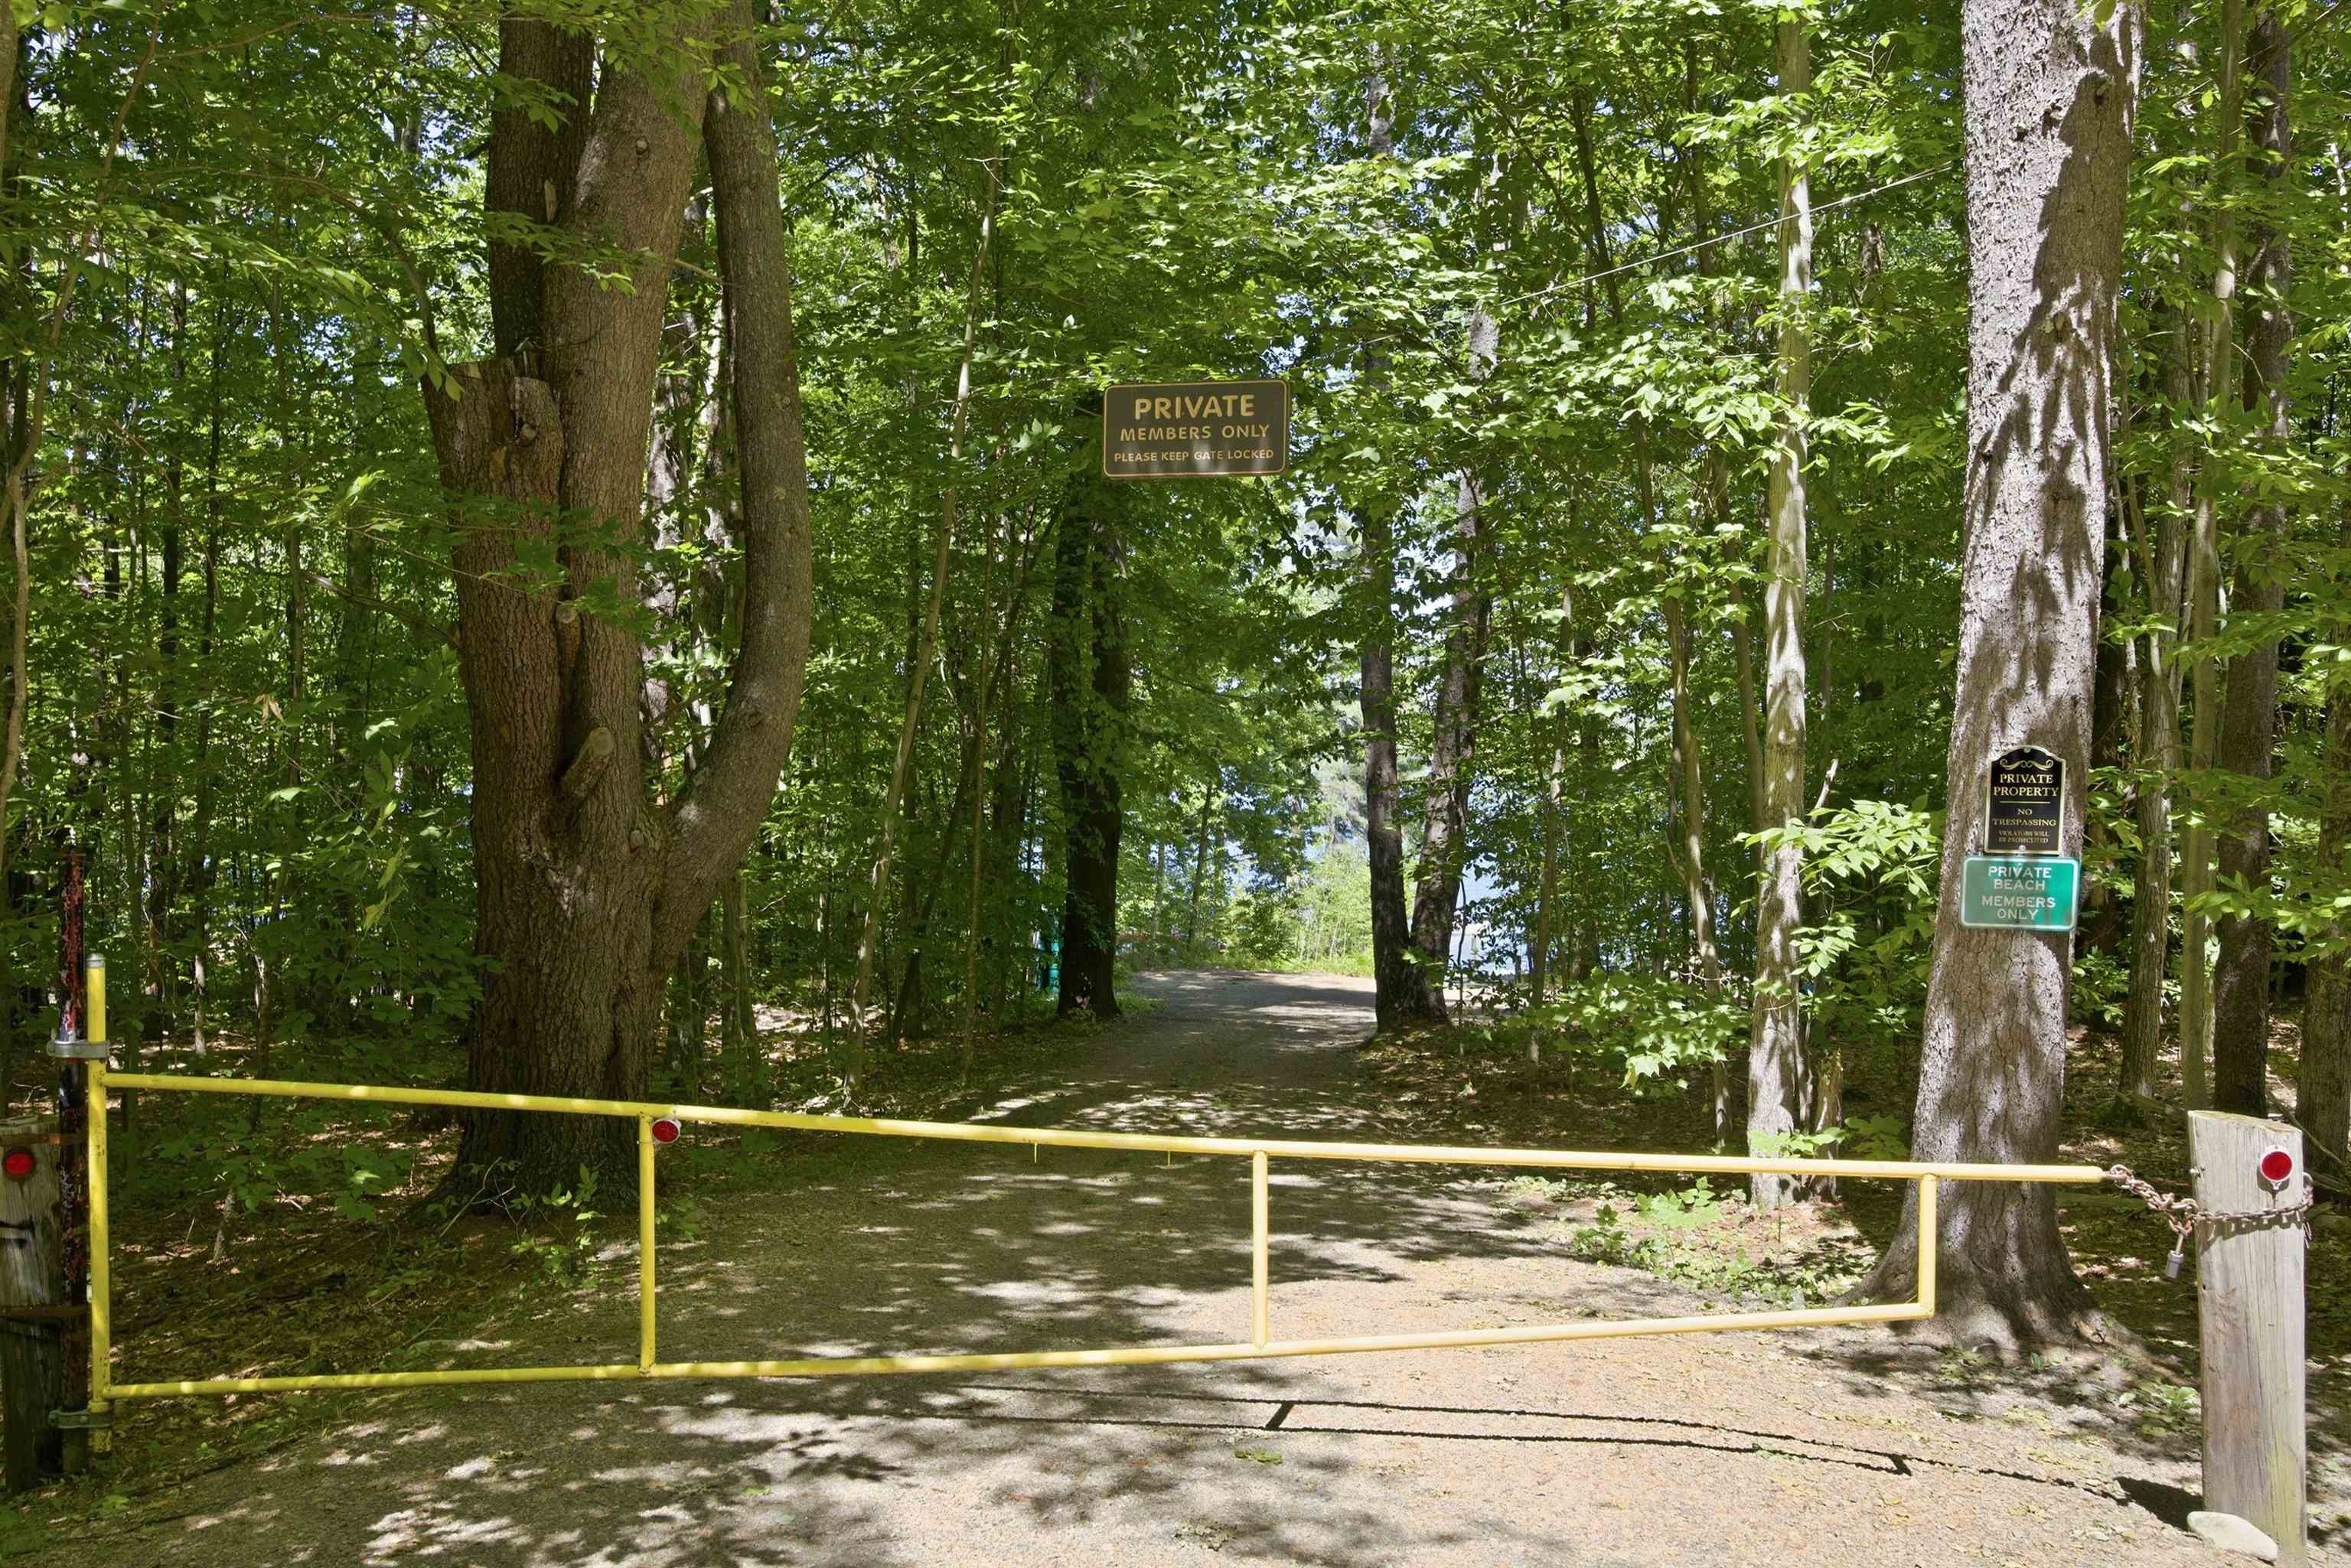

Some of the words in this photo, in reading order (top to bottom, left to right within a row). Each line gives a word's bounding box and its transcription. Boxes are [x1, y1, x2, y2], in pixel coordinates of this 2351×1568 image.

[1134, 394, 1255, 420] PRIVATE
[1120, 425, 1211, 442] MEMBERS
[1221, 424, 1269, 438] ONLY
[1114, 451, 1157, 462] PLEASE
[1162, 451, 1189, 461] KEEP
[1194, 451, 1223, 460] GATE
[1228, 449, 1273, 459] LOCKED
[2000, 774, 2053, 784] PRIVATE
[1993, 786, 2059, 797] PROPERTY
[1993, 818, 2057, 826] TRESPASSING
[1988, 865, 2052, 879] PRIVATE
[1994, 879, 2045, 891] BEACH
[1981, 896, 2056, 908] MEMBERS
[1997, 908, 2039, 920] ONLY
